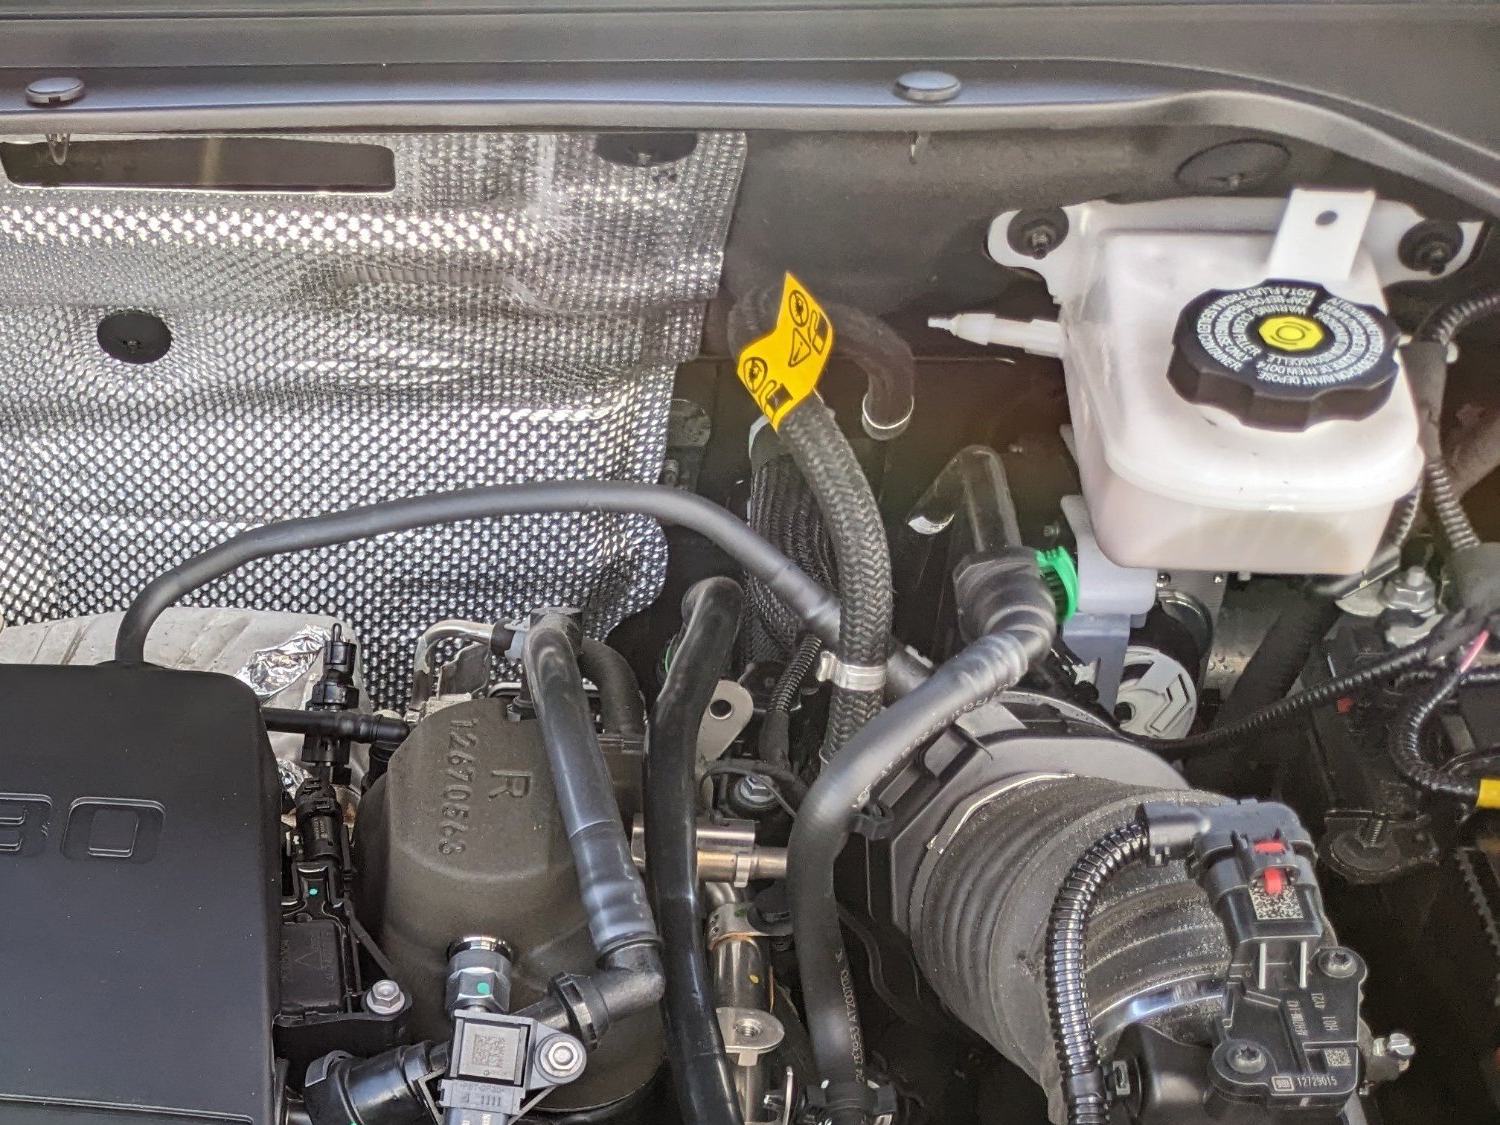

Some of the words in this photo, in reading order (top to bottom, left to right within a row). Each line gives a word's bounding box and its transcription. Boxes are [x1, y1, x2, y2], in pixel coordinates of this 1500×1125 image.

[1244, 287, 1280, 297] FLUID
[1214, 291, 1248, 307] FROM
[1285, 295, 1313, 305] CAP
[1286, 366, 1318, 375] FREIN
[1300, 373, 1338, 385] AVANT
[488, 770, 534, 800] R
[1297, 1076, 1337, 1087] 12729015
